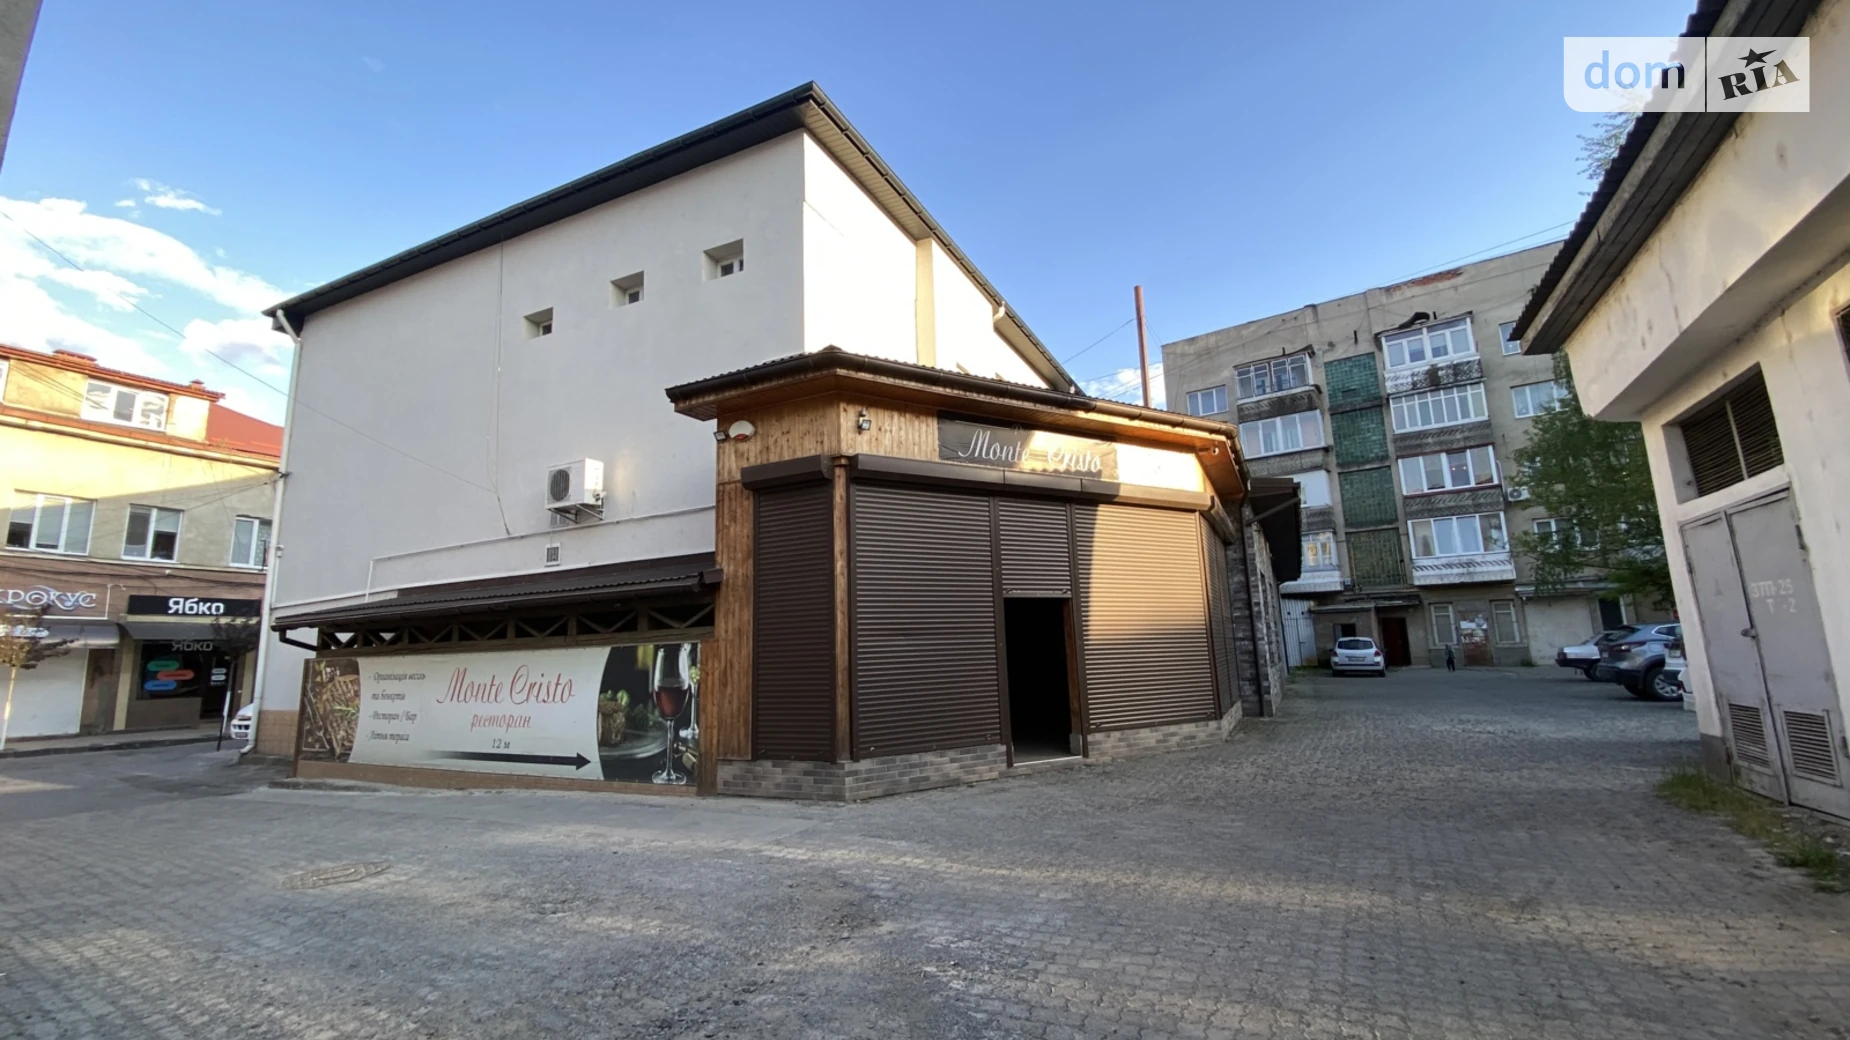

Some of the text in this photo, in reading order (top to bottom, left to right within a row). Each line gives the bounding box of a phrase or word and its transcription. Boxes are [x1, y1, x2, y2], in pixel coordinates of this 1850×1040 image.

[958, 429, 1030, 463] Monte
[1047, 447, 1102, 472] Cristo
[167, 597, 225, 615] Ябко
[436, 664, 576, 705] Monte Cristo
[470, 713, 532, 732] ресторан
[492, 738, 502, 749] 12
